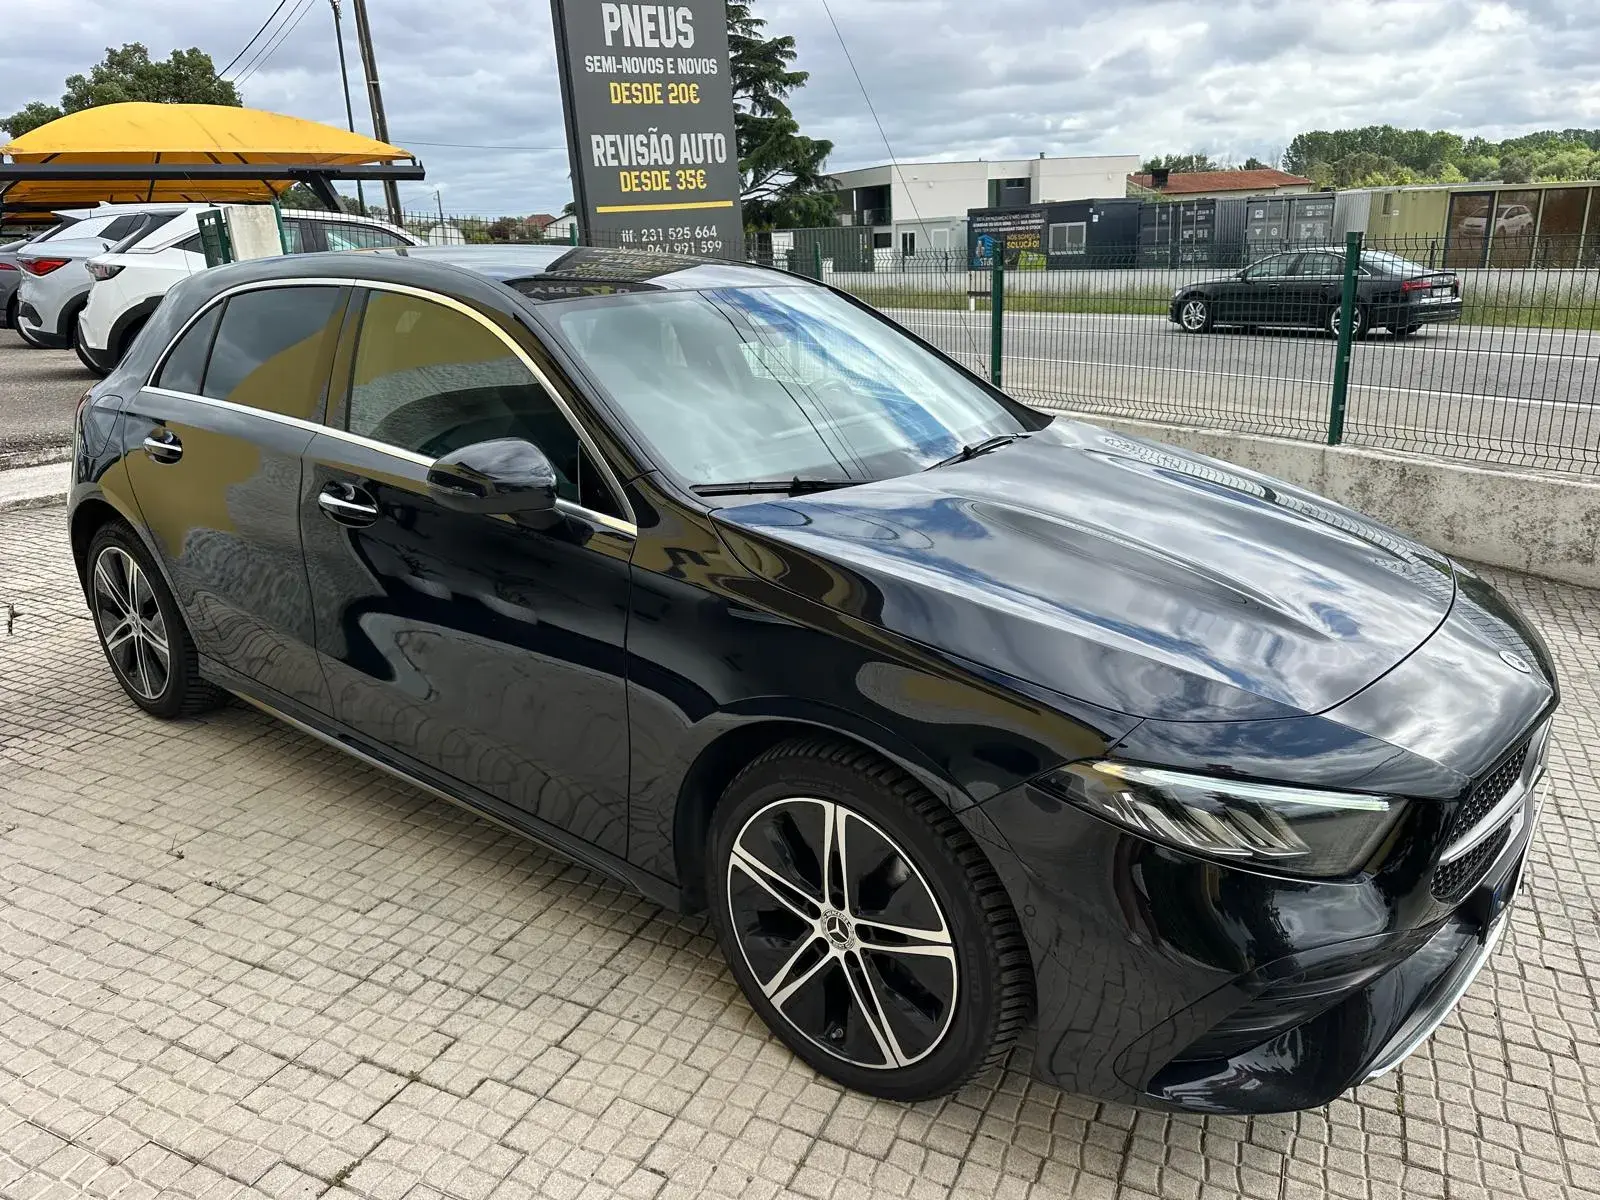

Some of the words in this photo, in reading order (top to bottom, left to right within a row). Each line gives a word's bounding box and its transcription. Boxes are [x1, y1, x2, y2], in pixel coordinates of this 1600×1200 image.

[601, 2, 695, 49] PNEUS
[584, 55, 665, 74] SEMI-NOVOS
[666, 57, 676, 74] E
[677, 57, 718, 75] NOVOS
[609, 82, 664, 105] DESDE
[667, 82, 701, 104] 20€
[590, 127, 675, 167] REVISÃO
[680, 132, 727, 165] AUTO
[619, 170, 673, 192] DESDE
[675, 169, 707, 191] 35€
[641, 228, 664, 242] 231
[668, 226, 692, 240] 525
[695, 224, 718, 238] 664
[674, 241, 696, 255] 991
[700, 239, 723, 253] 599
